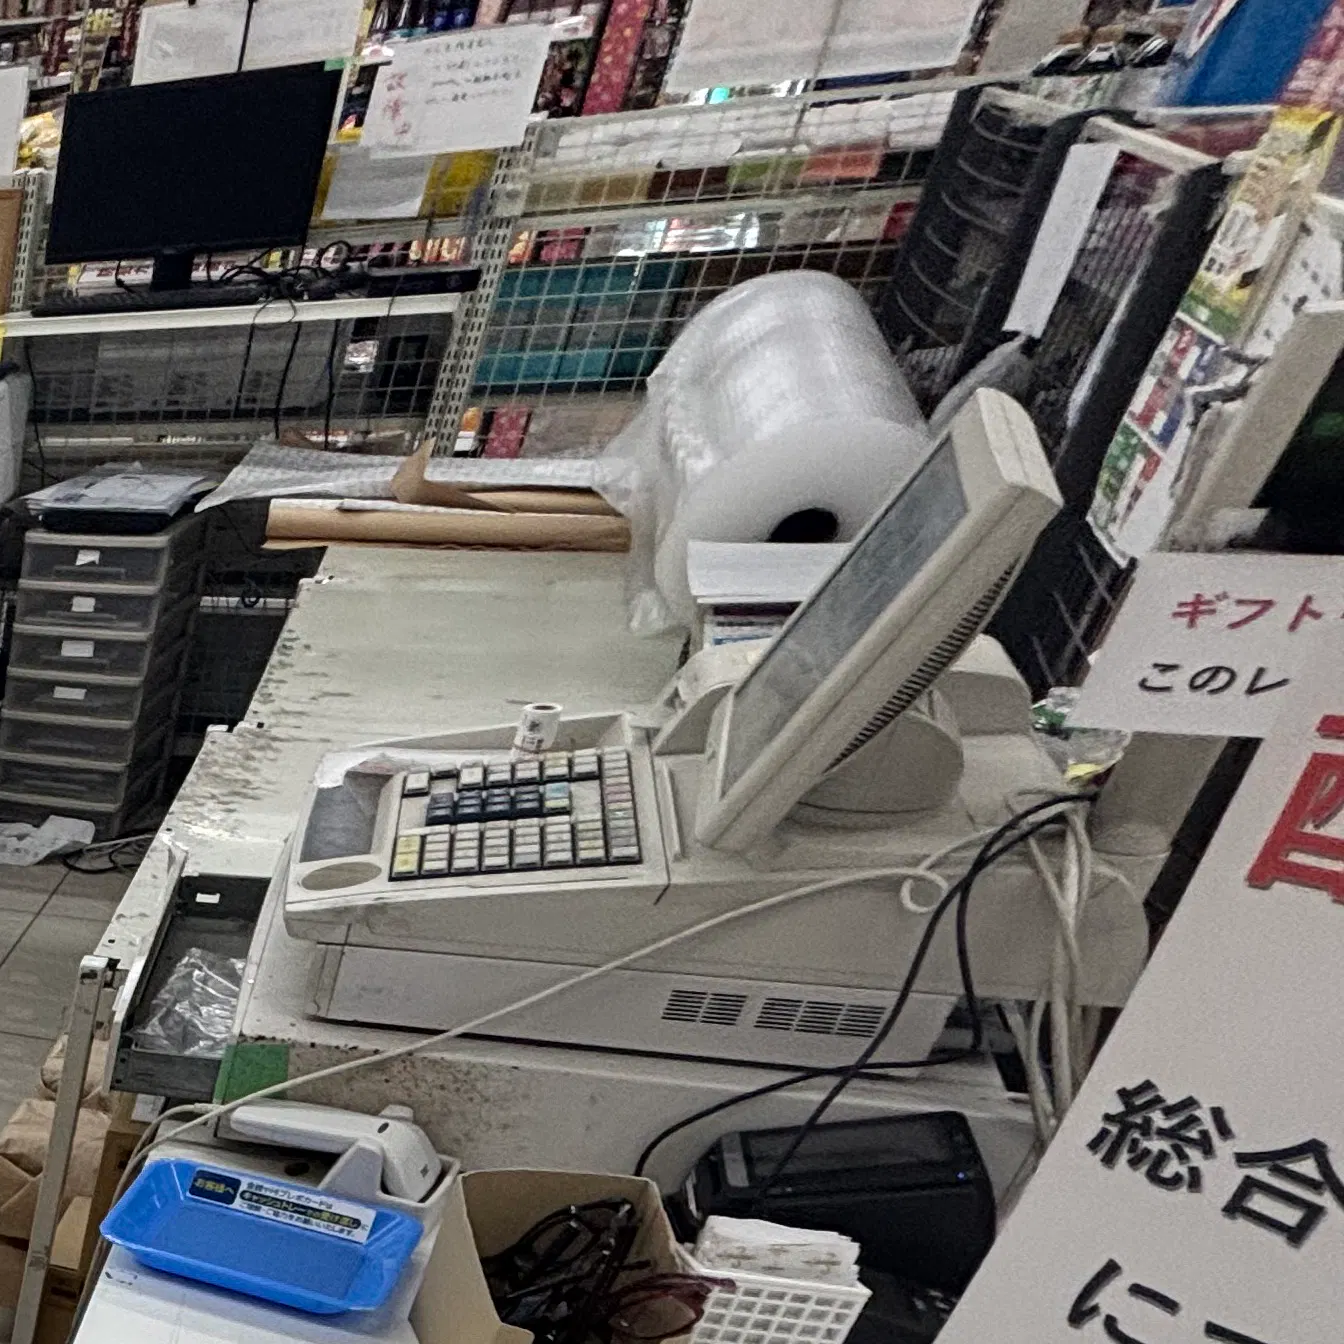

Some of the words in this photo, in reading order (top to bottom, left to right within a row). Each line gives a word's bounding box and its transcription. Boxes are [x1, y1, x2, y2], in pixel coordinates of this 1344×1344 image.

[1172, 591, 1344, 634] ギフト
[1138, 662, 1291, 697] このレ
[1085, 1078, 1344, 1249] 総合
